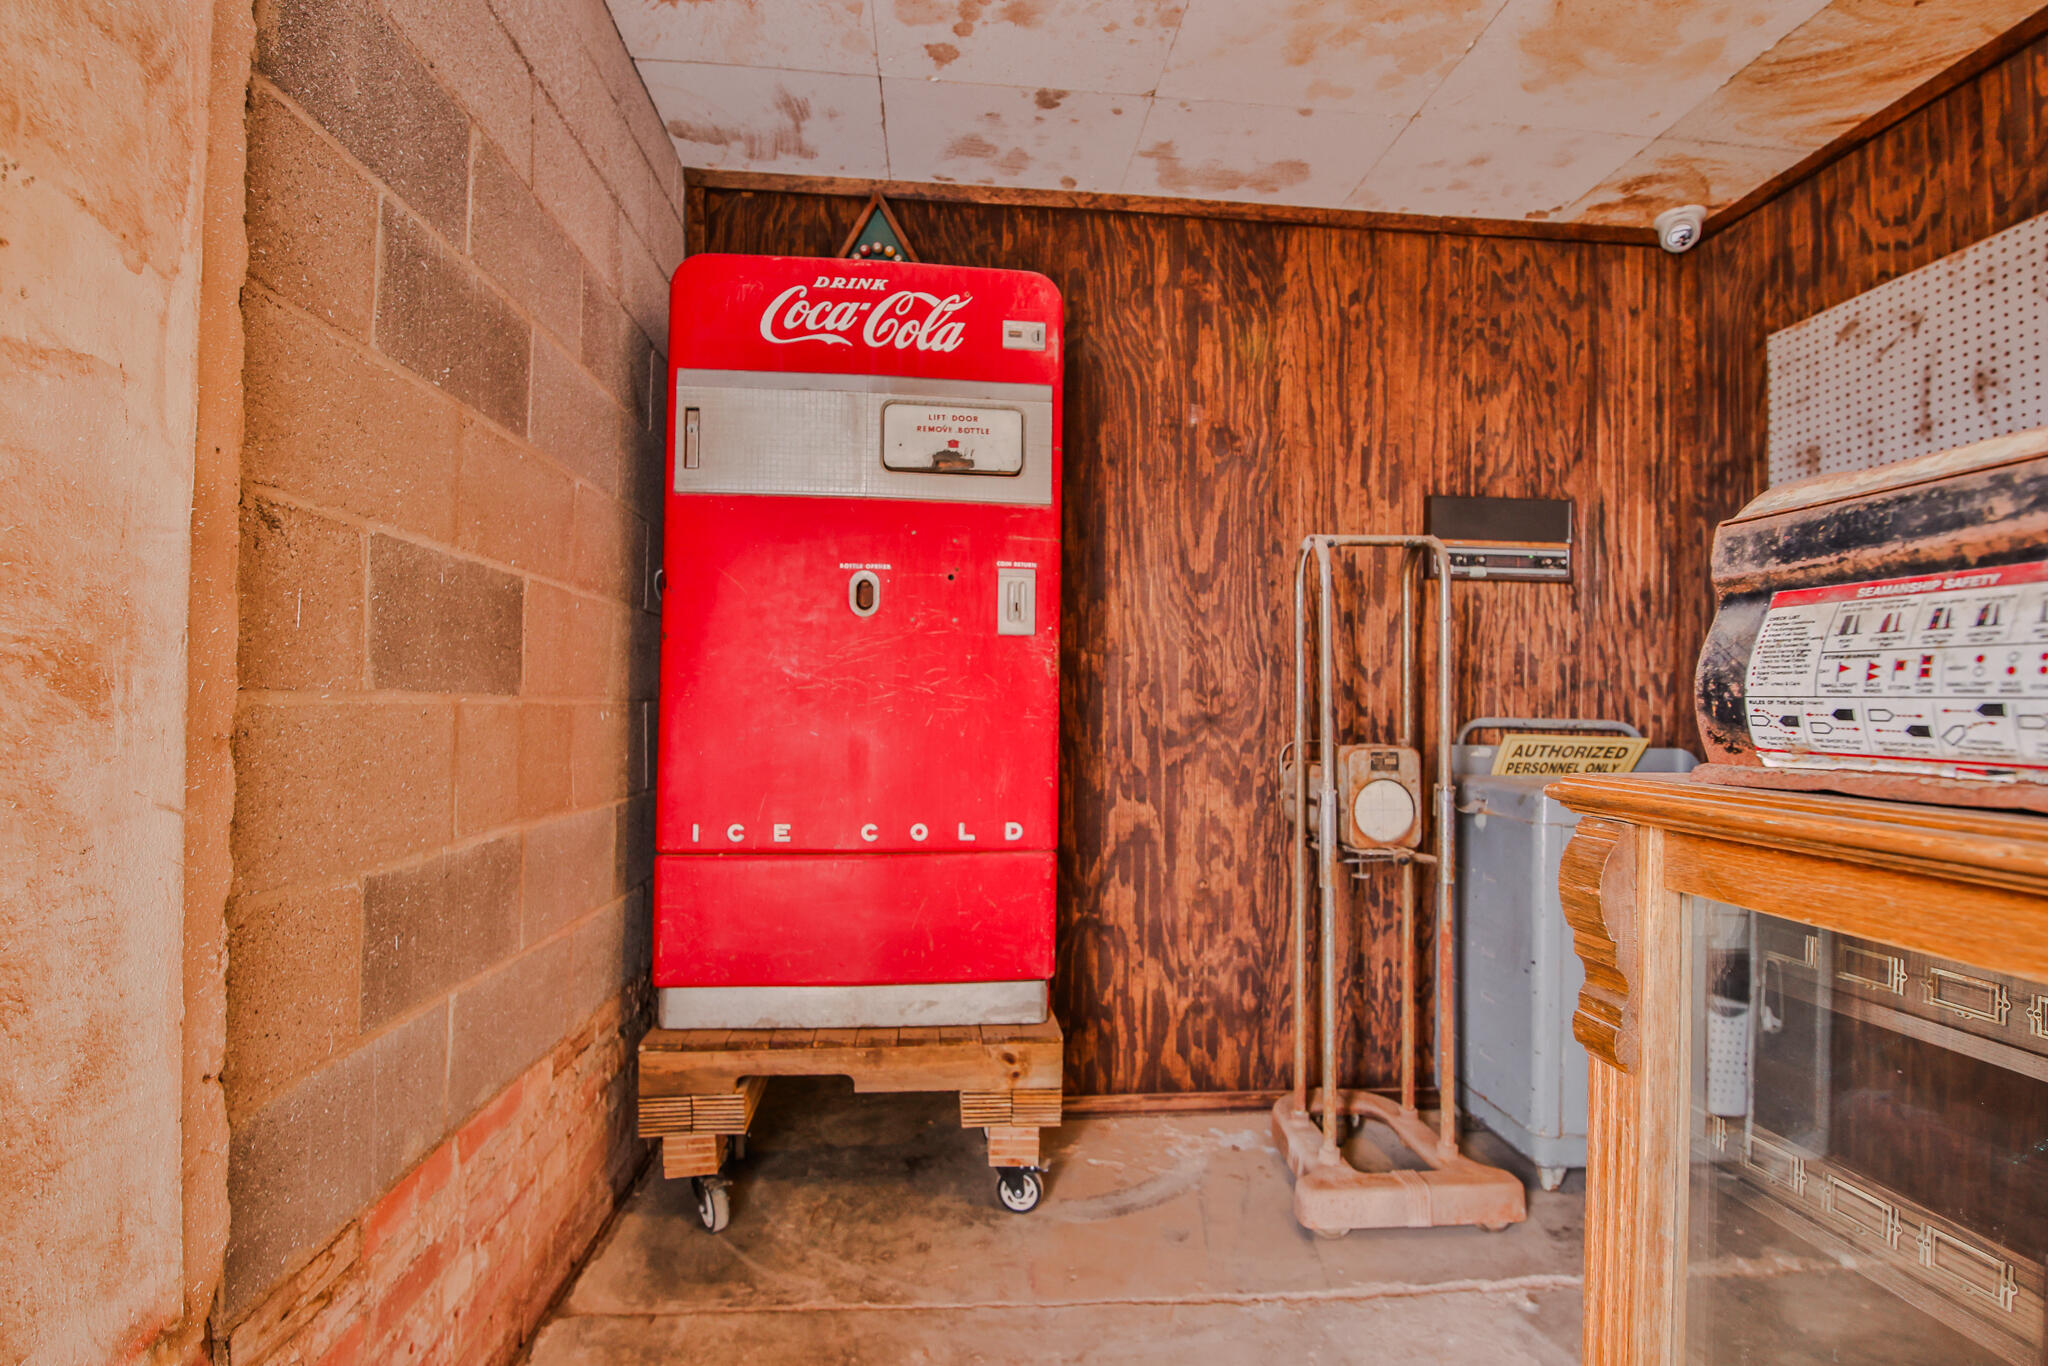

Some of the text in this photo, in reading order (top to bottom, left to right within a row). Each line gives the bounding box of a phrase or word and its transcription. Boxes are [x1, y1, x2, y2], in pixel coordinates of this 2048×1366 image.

[812, 276, 888, 291] DRINK
[759, 285, 973, 352] Coca-Cola
[958, 427, 991, 435] BOTTLE
[1013, 561, 1037, 569] RETURN
[1856, 573, 2002, 598] SEAMANSHIP SAFETY
[1511, 744, 1630, 759] AUTHORIZED
[1505, 762, 1621, 774] PERSONNEL ONLY
[692, 821, 1024, 843] ICE COLD
